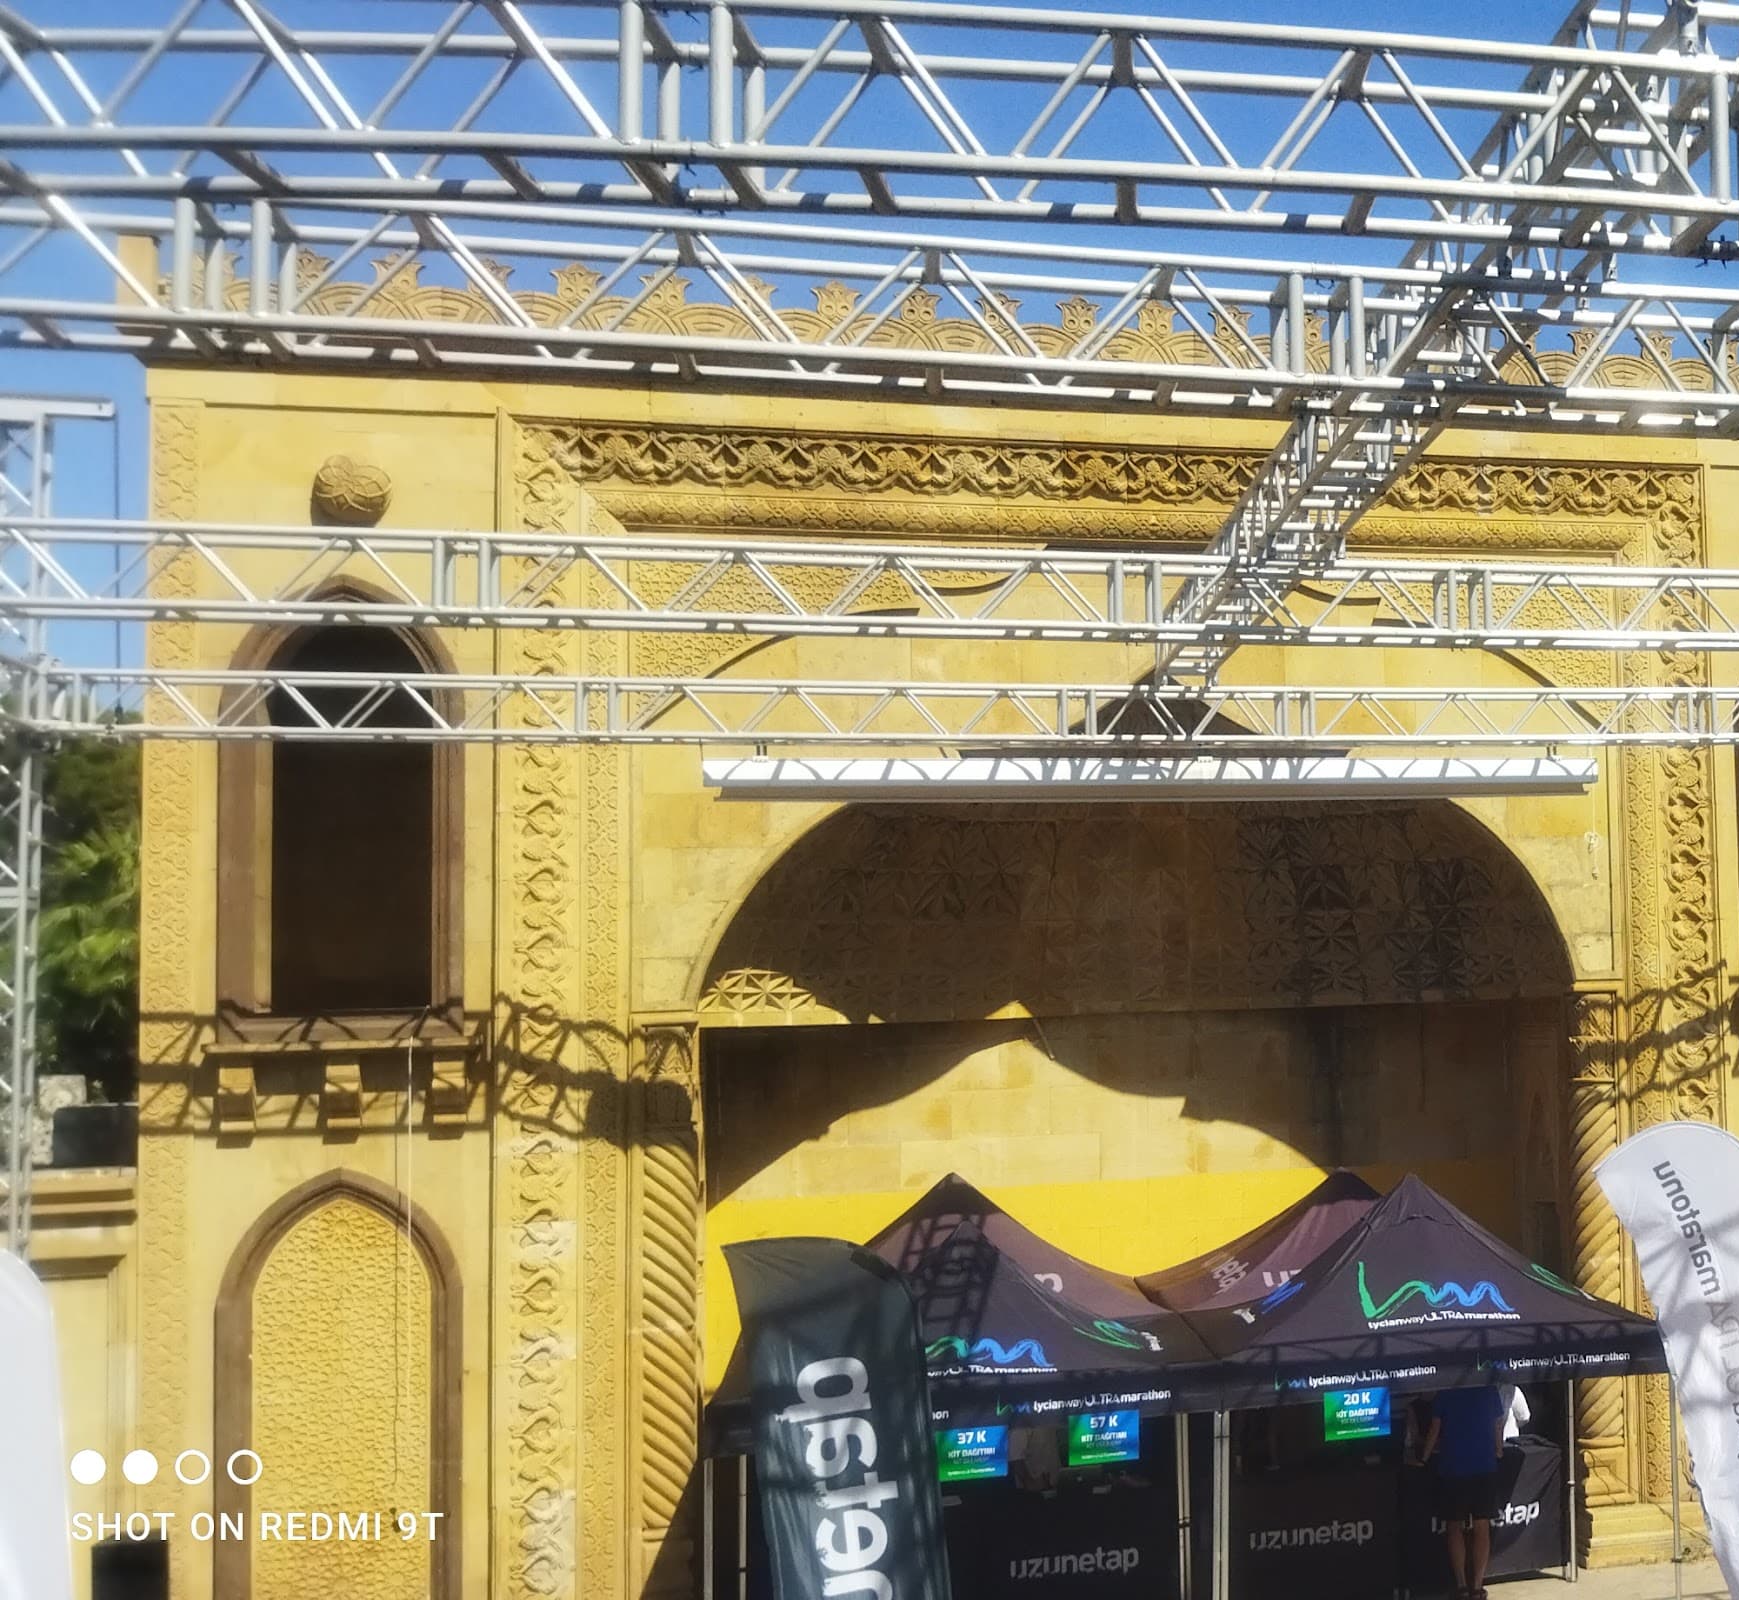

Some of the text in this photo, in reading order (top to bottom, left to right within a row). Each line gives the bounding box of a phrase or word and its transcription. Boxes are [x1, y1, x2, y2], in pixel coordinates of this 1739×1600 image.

[1343, 1391, 1371, 1406] 20 K
[1090, 1414, 1119, 1429] 57 K
[957, 1430, 987, 1445] 37 K
[1249, 1518, 1374, 1552] uzunetap
[1010, 1545, 1140, 1579] uzunetap
